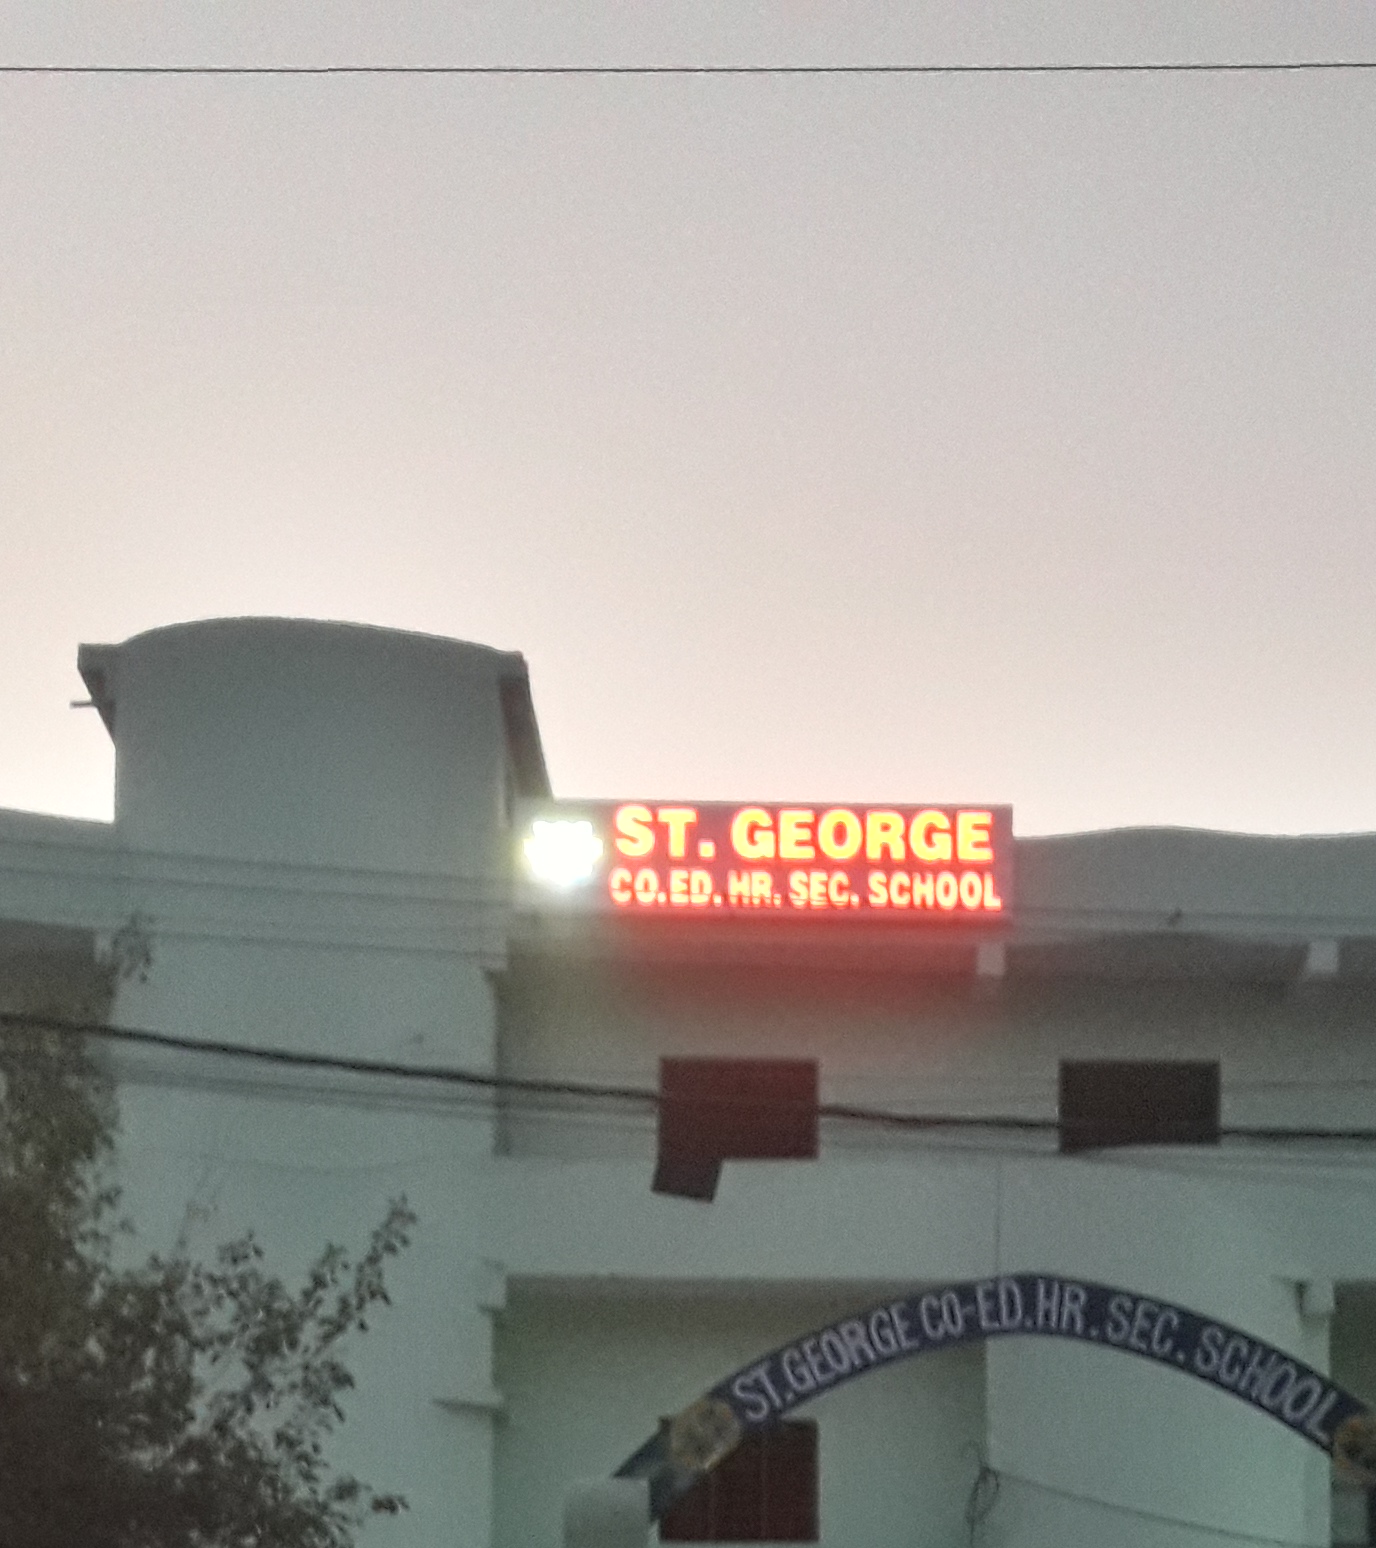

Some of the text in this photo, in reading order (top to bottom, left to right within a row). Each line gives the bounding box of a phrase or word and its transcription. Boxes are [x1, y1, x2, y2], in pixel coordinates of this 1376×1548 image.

[613, 804, 995, 863] ST. GEORGE
[726, 868, 783, 909] HR.
[788, 869, 861, 909] SEC.
[867, 870, 1003, 912] SCHOOL
[1106, 1296, 1186, 1363] SEC.
[1195, 1324, 1339, 1446] SCHOOL
